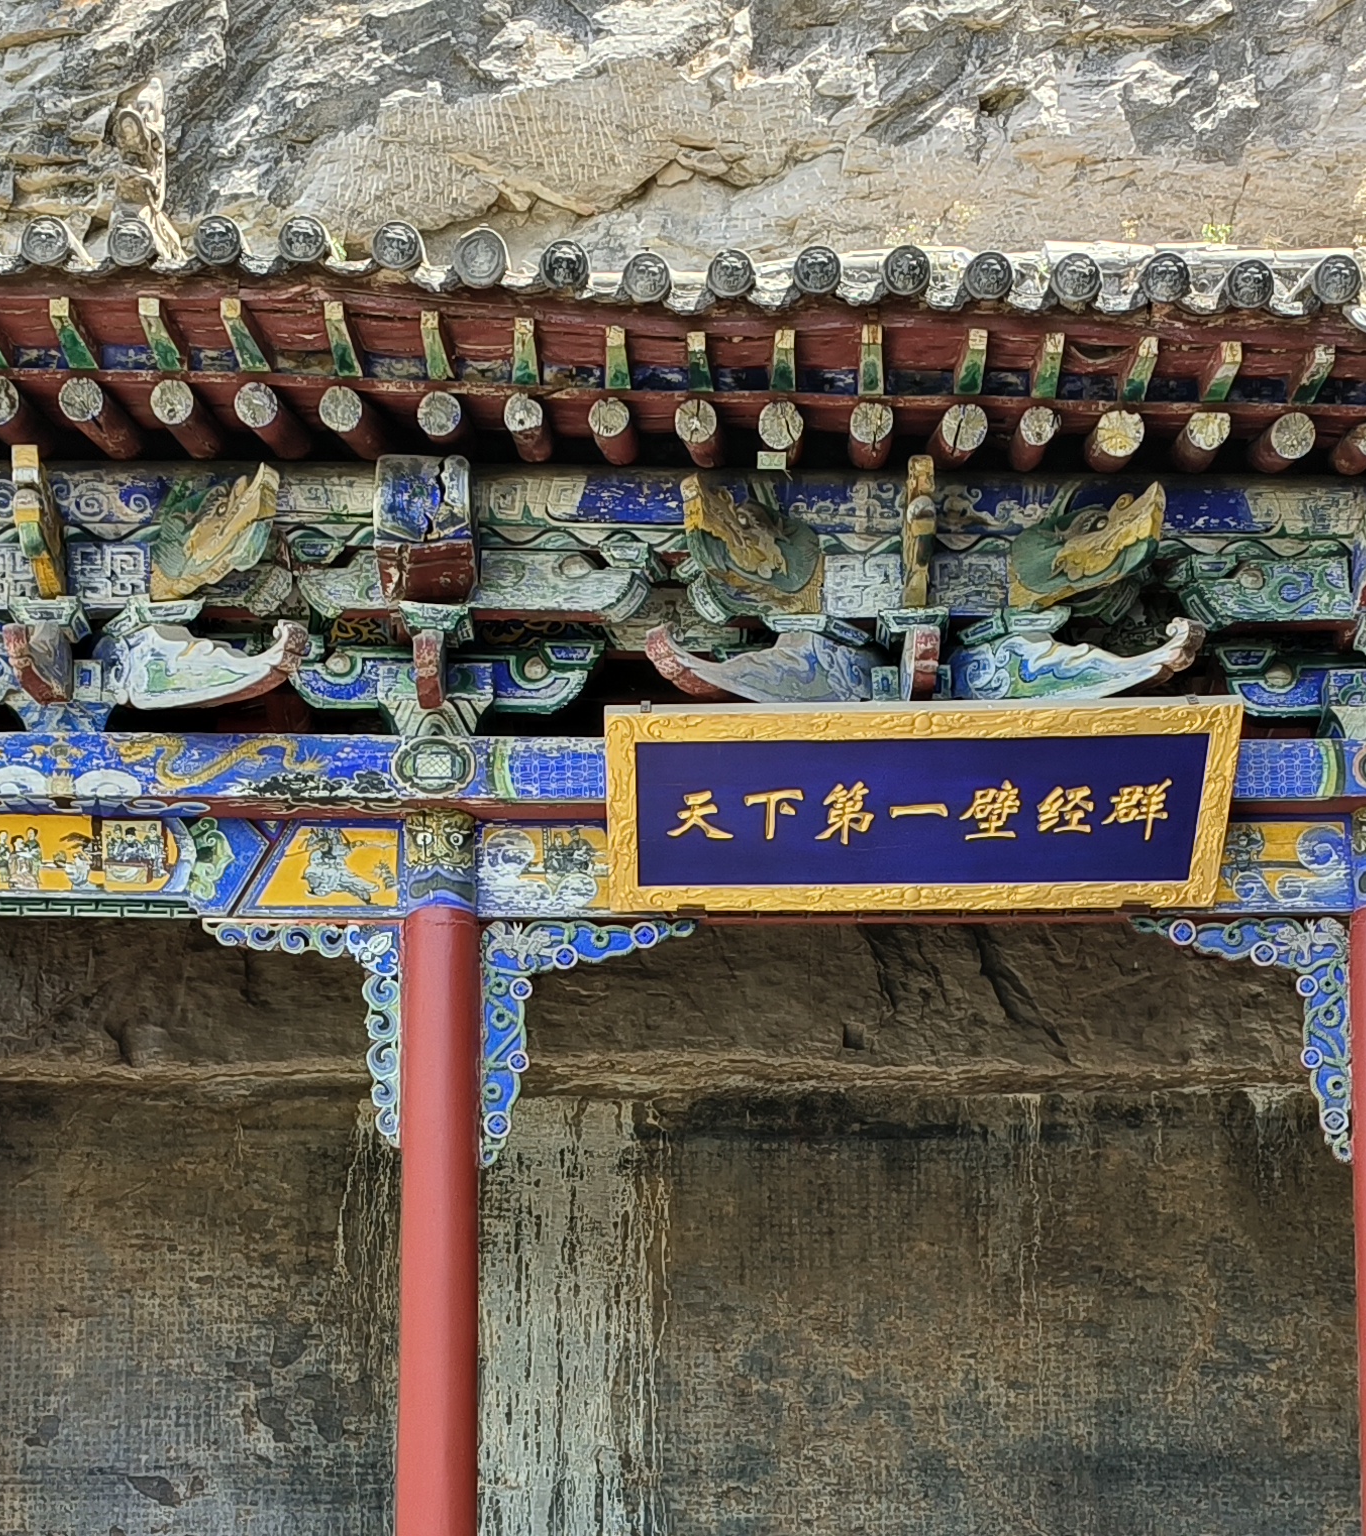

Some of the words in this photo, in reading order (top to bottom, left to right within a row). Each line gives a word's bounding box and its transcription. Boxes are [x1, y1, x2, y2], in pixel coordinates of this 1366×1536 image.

[666, 778, 1174, 845] 天下第一壁经群
